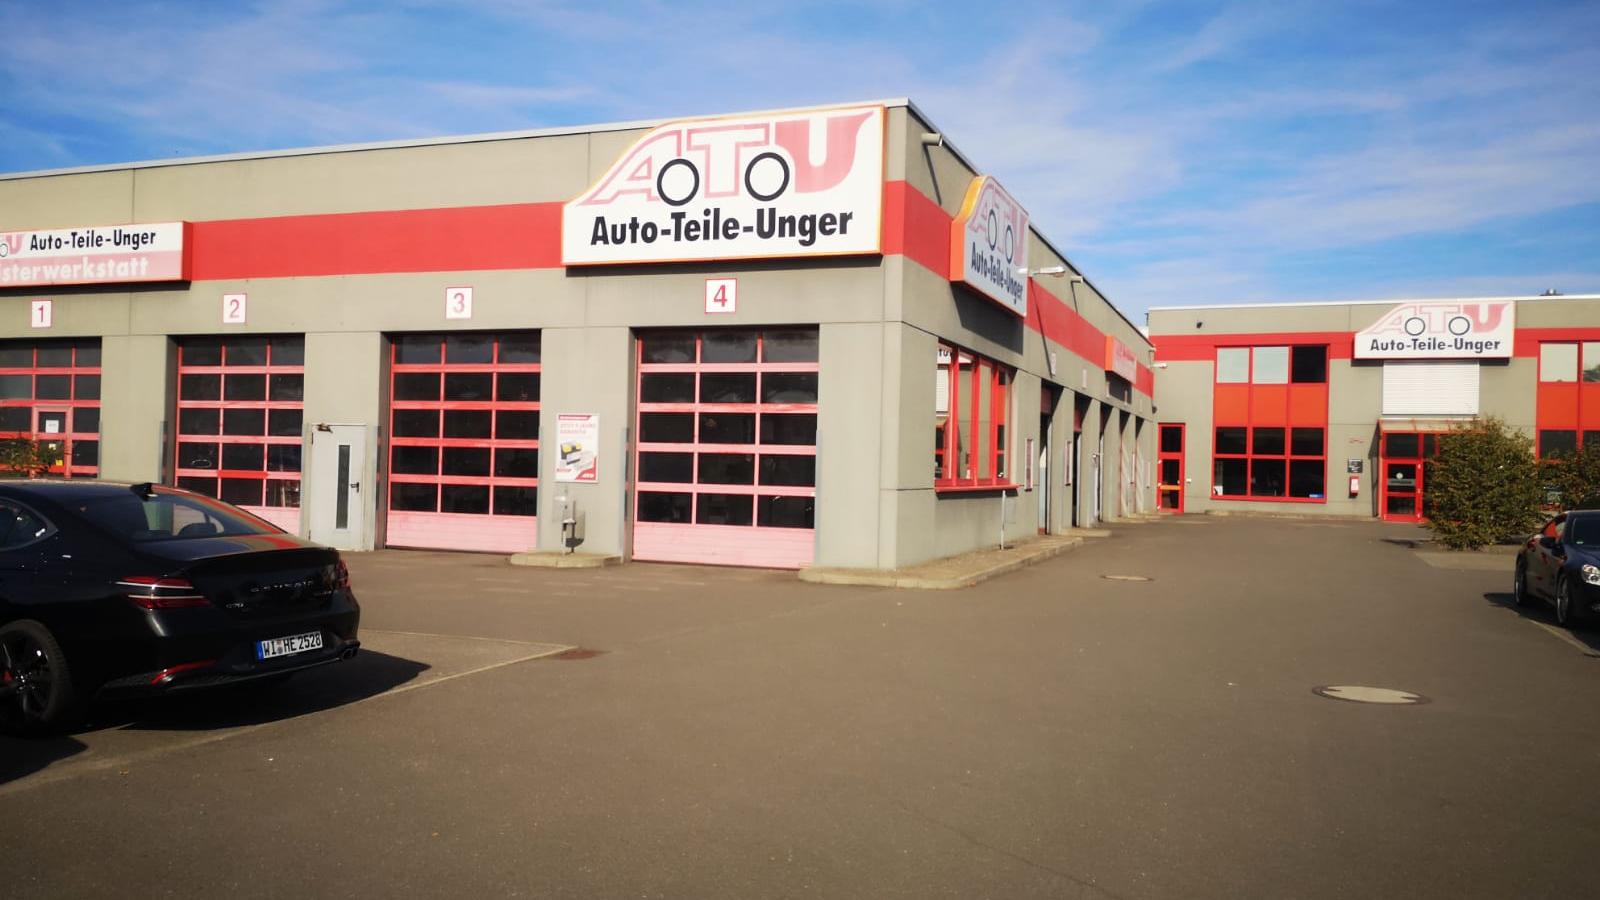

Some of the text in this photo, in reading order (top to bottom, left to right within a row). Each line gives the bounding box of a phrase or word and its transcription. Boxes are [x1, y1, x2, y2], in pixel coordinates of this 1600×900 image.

[590, 207, 853, 247] Auto-Teile-Unger
[30, 229, 156, 250] Auto-Teile-Unger
[0, 257, 149, 282] sterwerkstatt
[971, 242, 1024, 304] Auto-Teile-Unger
[453, 292, 465, 313] 3
[713, 284, 728, 307] 4
[229, 299, 240, 319] 2
[1370, 337, 1500, 354] Auto-Teile-Unger
[283, 637, 297, 653] HE
[298, 632, 322, 650] 2528
